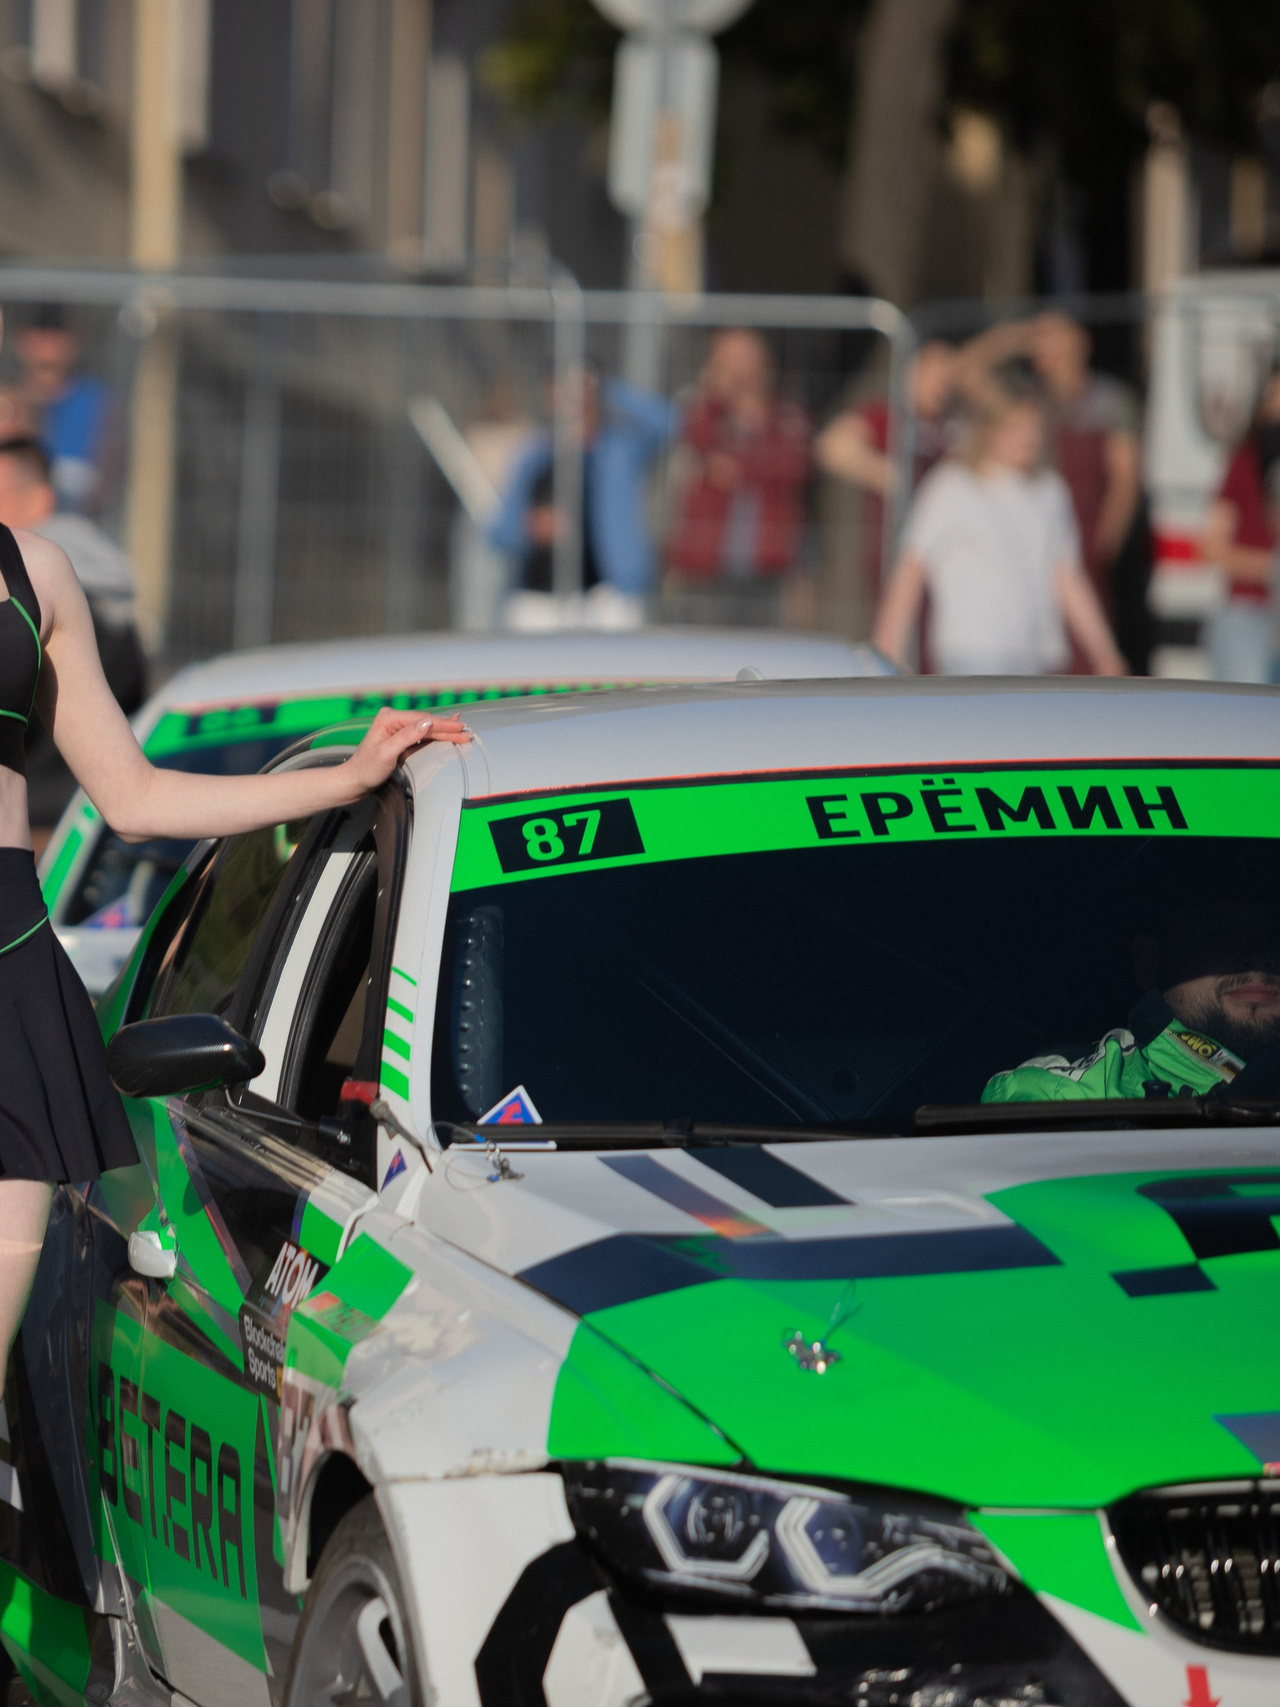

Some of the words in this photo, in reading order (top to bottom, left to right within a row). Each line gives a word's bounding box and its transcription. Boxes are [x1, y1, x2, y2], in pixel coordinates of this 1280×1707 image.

[521, 808, 603, 862] 87
[805, 778, 1189, 840] ЕРЁМИН
[264, 1241, 319, 1310] ATOM
[243, 1314, 286, 1364] Blockchai
[248, 1346, 277, 1390] Sports
[97, 1361, 248, 1600] BETERA
